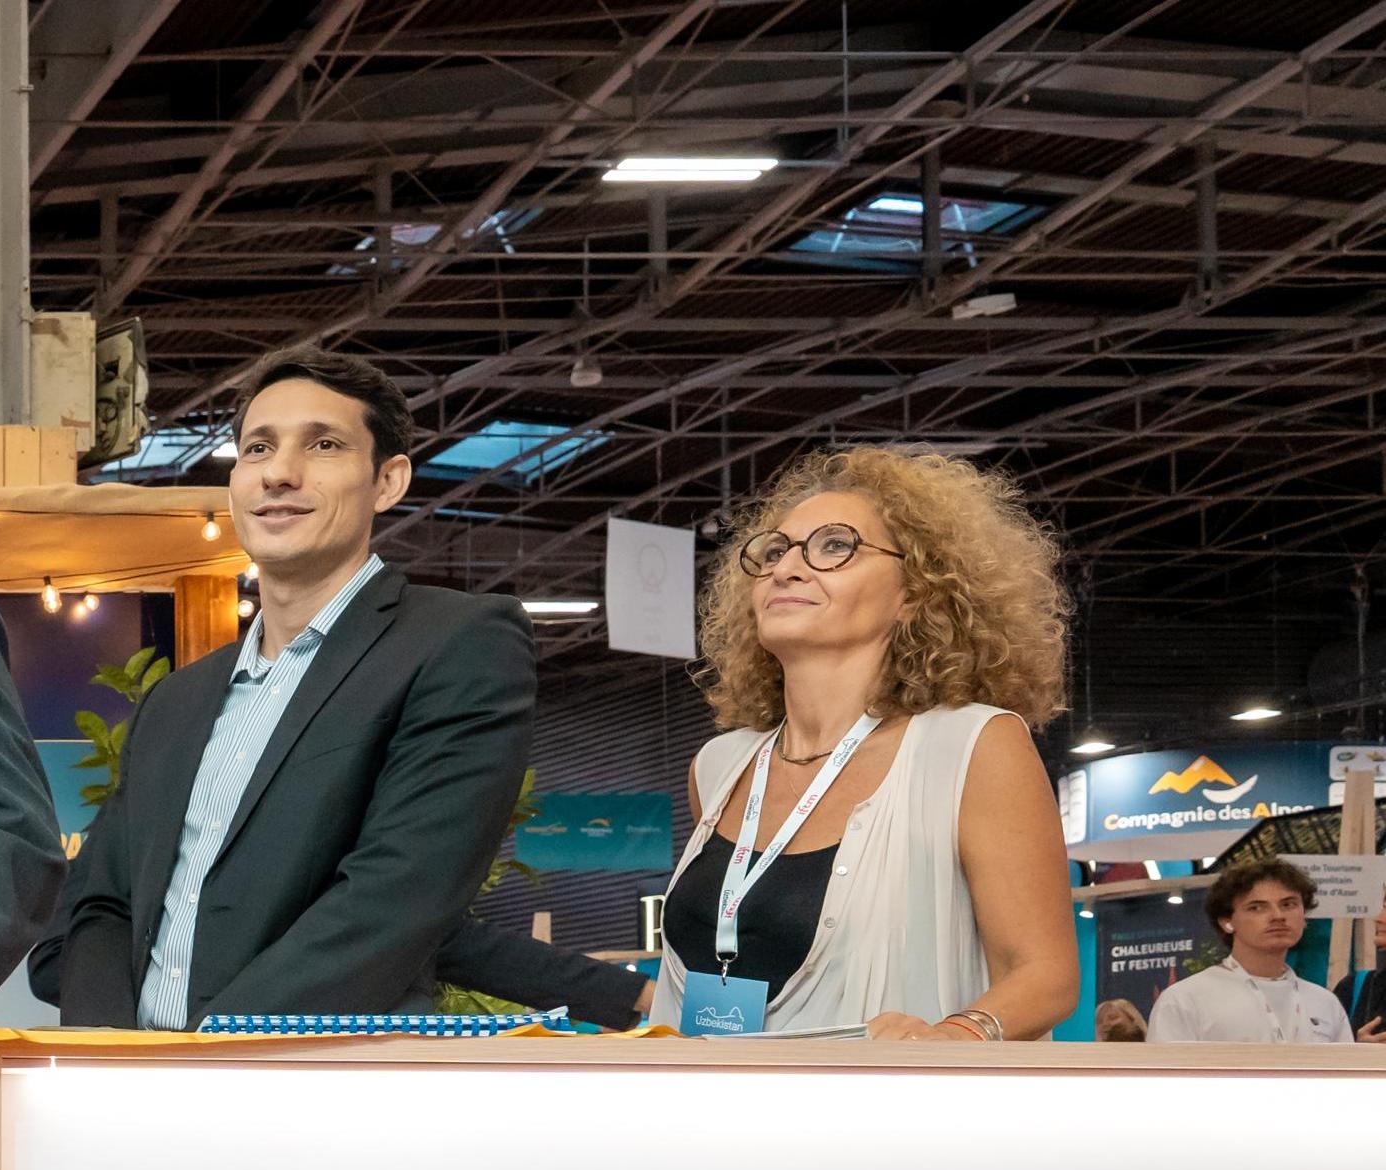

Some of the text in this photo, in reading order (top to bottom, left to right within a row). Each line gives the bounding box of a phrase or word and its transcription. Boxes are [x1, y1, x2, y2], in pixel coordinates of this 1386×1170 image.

[1104, 805, 1216, 830] Compagnie
[1218, 804, 1251, 821] des
[1111, 939, 1193, 958] CHALEUREUSE
[1111, 956, 1177, 973] ET FESTIVE
[695, 1015, 744, 1032] Uzbekistan
